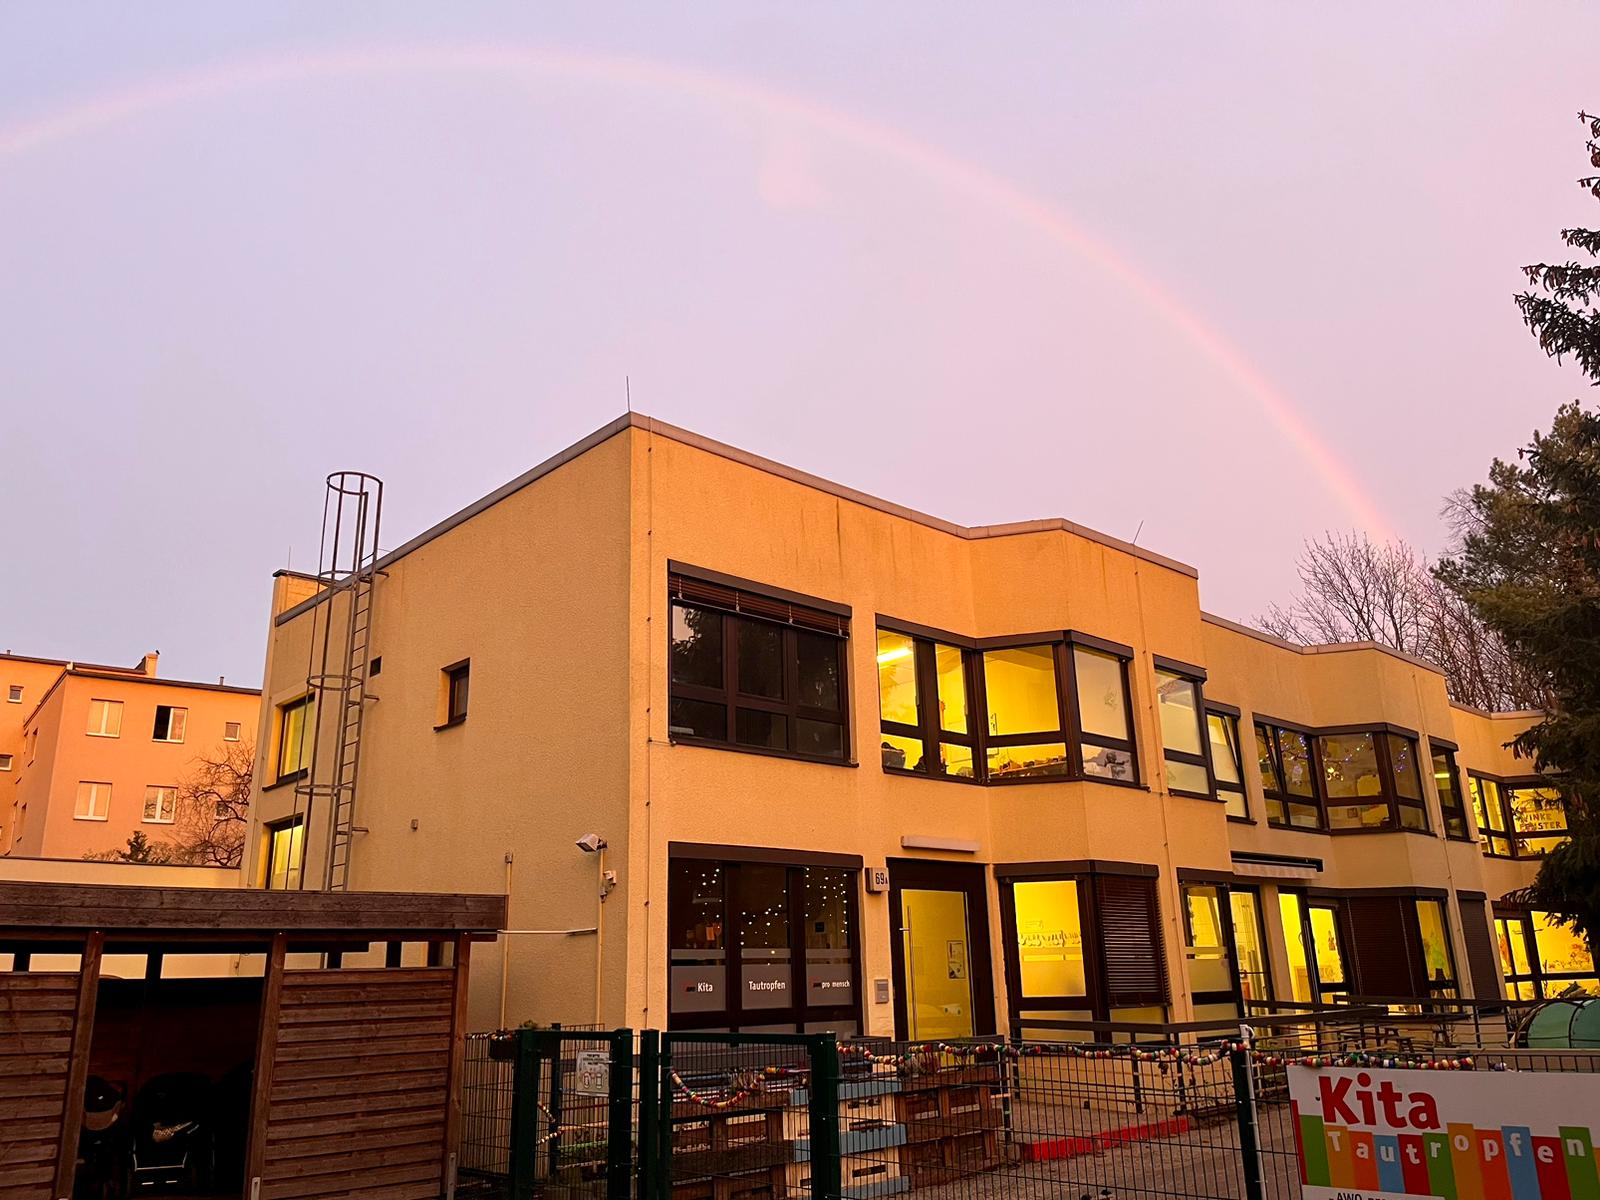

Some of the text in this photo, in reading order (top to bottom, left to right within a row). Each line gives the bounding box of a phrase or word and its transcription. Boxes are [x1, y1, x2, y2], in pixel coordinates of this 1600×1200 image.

[697, 982, 714, 992] Kita
[748, 980, 786, 992] Tautropfen
[821, 981, 831, 989] pro
[832, 980, 851, 988] mensch
[1318, 1072, 1441, 1130] Kita
[1327, 1131, 1586, 1165] Tautropfen
